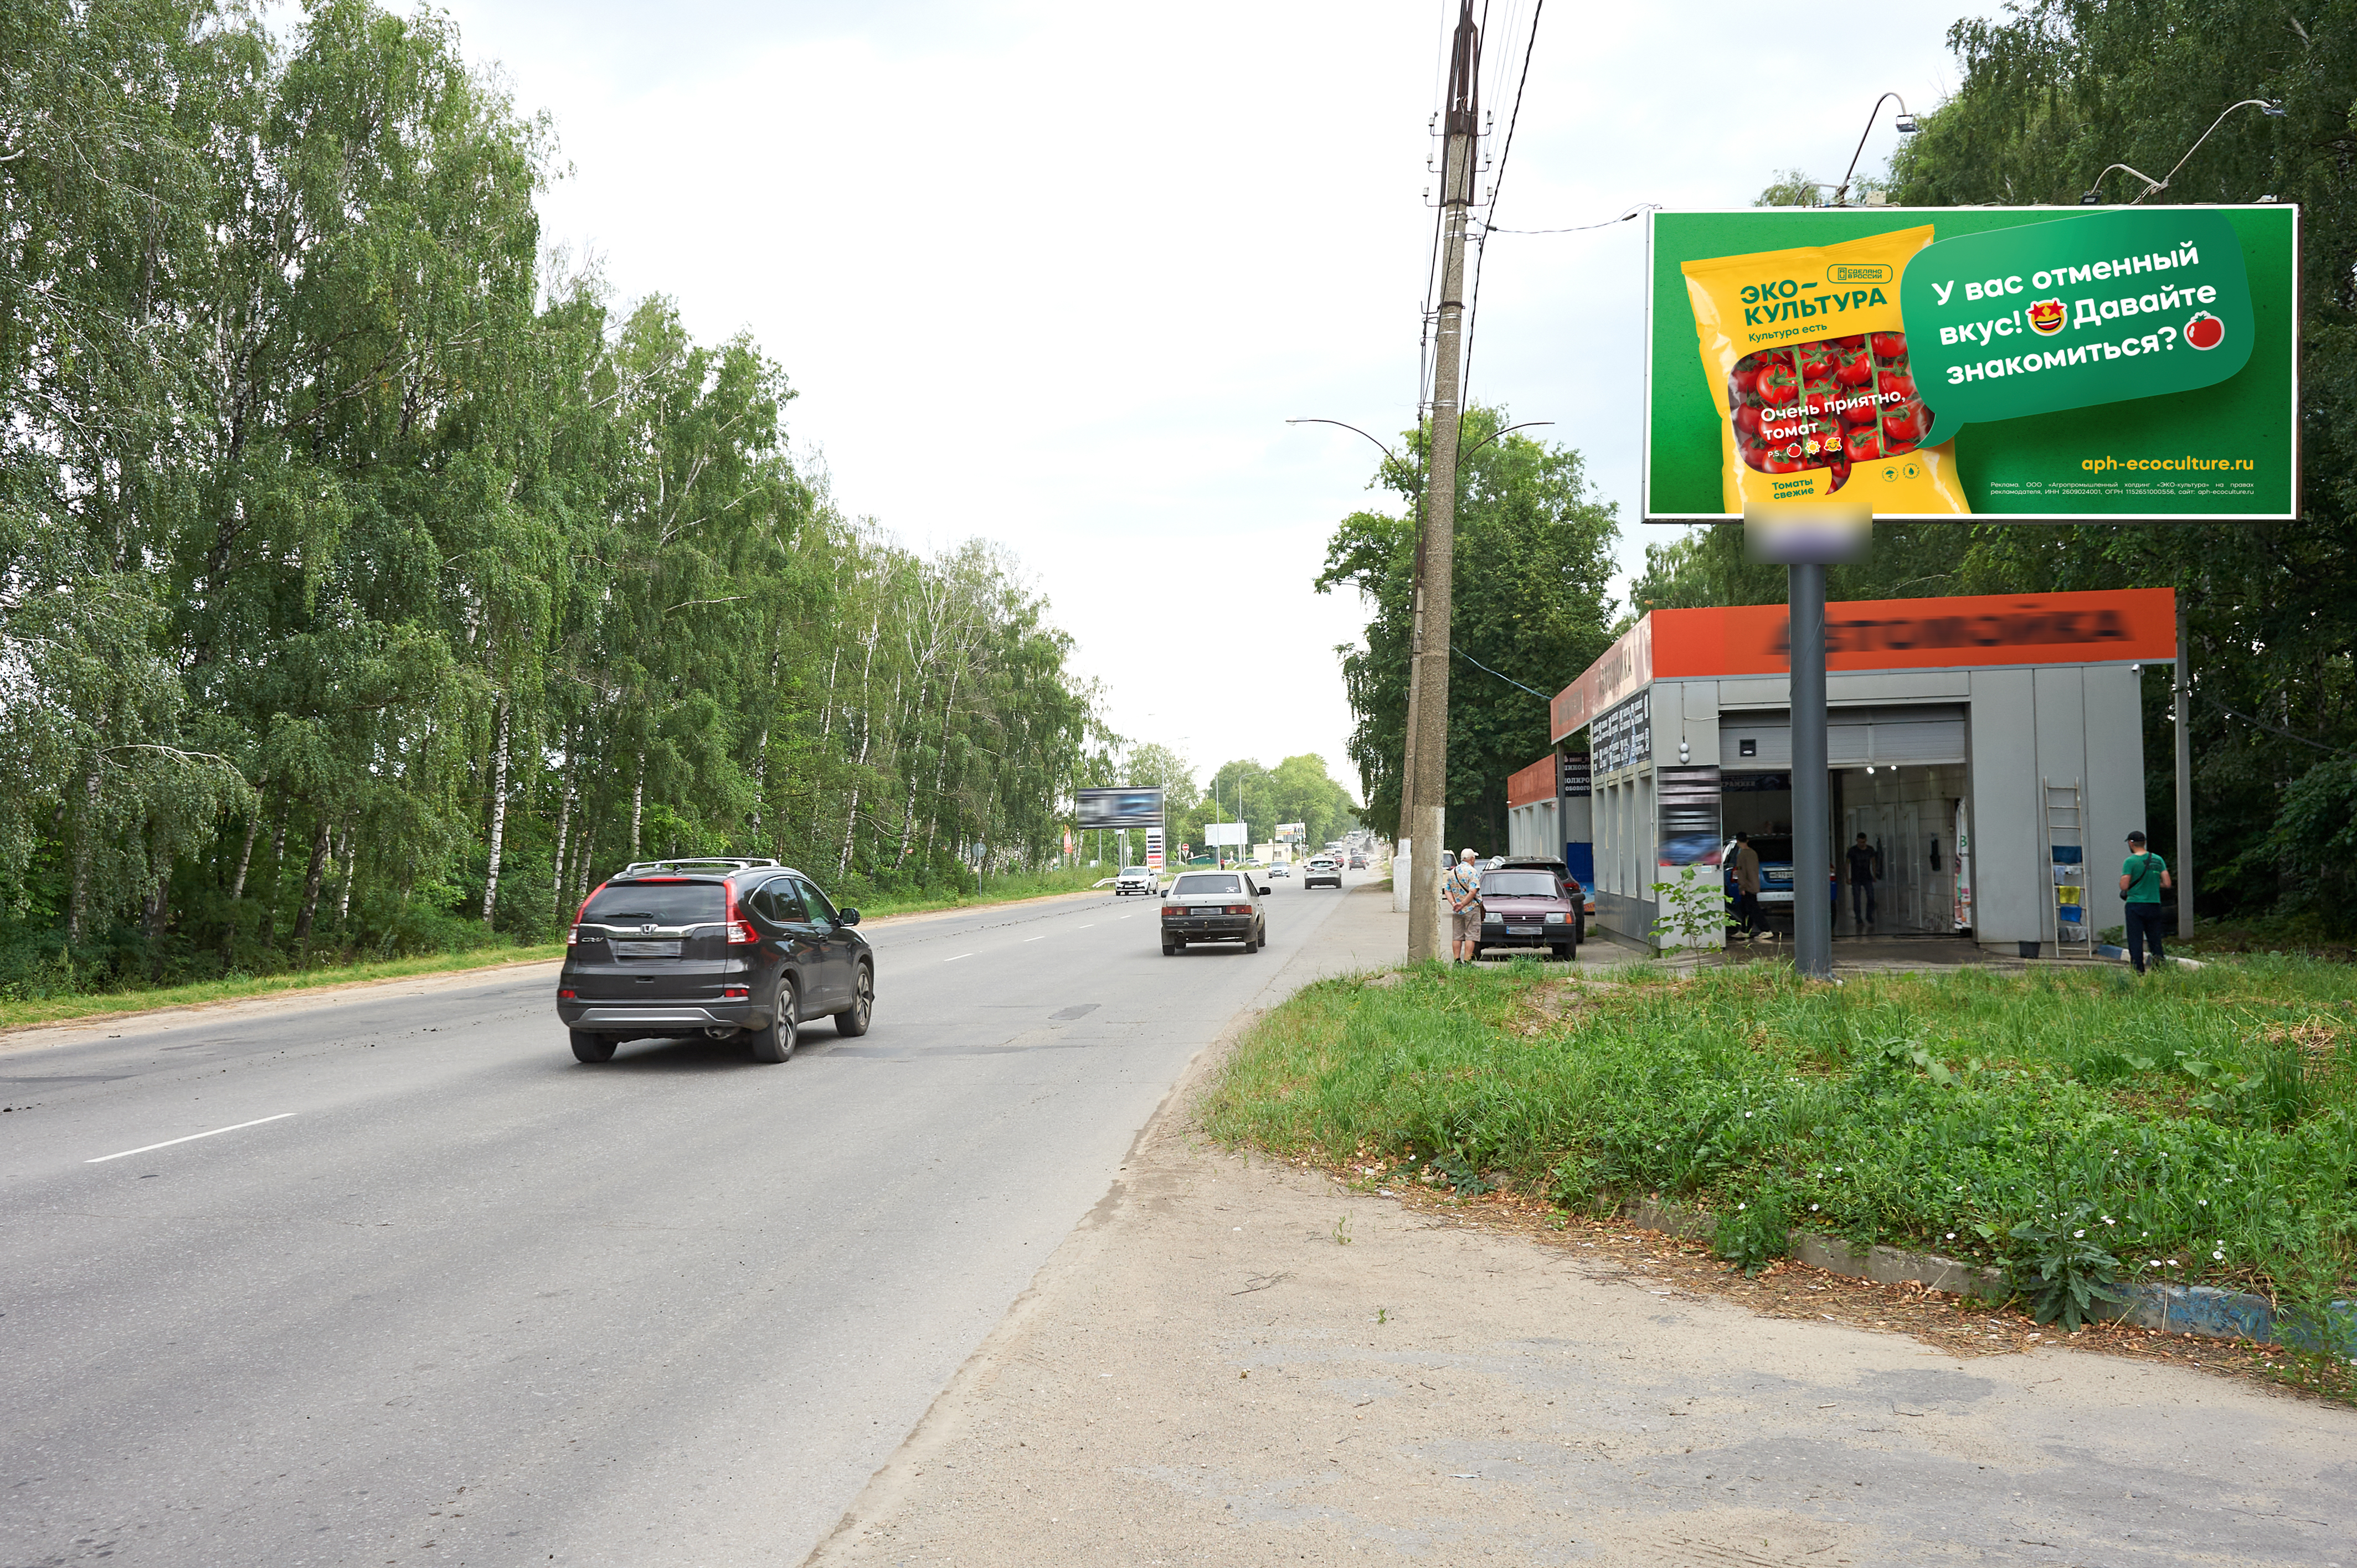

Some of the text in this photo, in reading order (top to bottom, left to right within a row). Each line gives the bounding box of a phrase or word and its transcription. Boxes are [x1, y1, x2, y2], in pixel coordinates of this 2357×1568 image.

[1931, 240, 2199, 306] У вас отменный
[1744, 287, 1888, 326] КУЛЬТУРА
[1939, 284, 2216, 346] вкус! Давайте
[1748, 324, 1828, 343] Культура есть
[1946, 326, 2177, 385] знакомиться?
[1761, 391, 1906, 422] Очень приятно,
[1763, 423, 1819, 440] томат
[2081, 455, 2253, 474] aph-ecoculture.ru
[1772, 479, 1813, 491] Томаты
[1773, 487, 1814, 499] свежие
